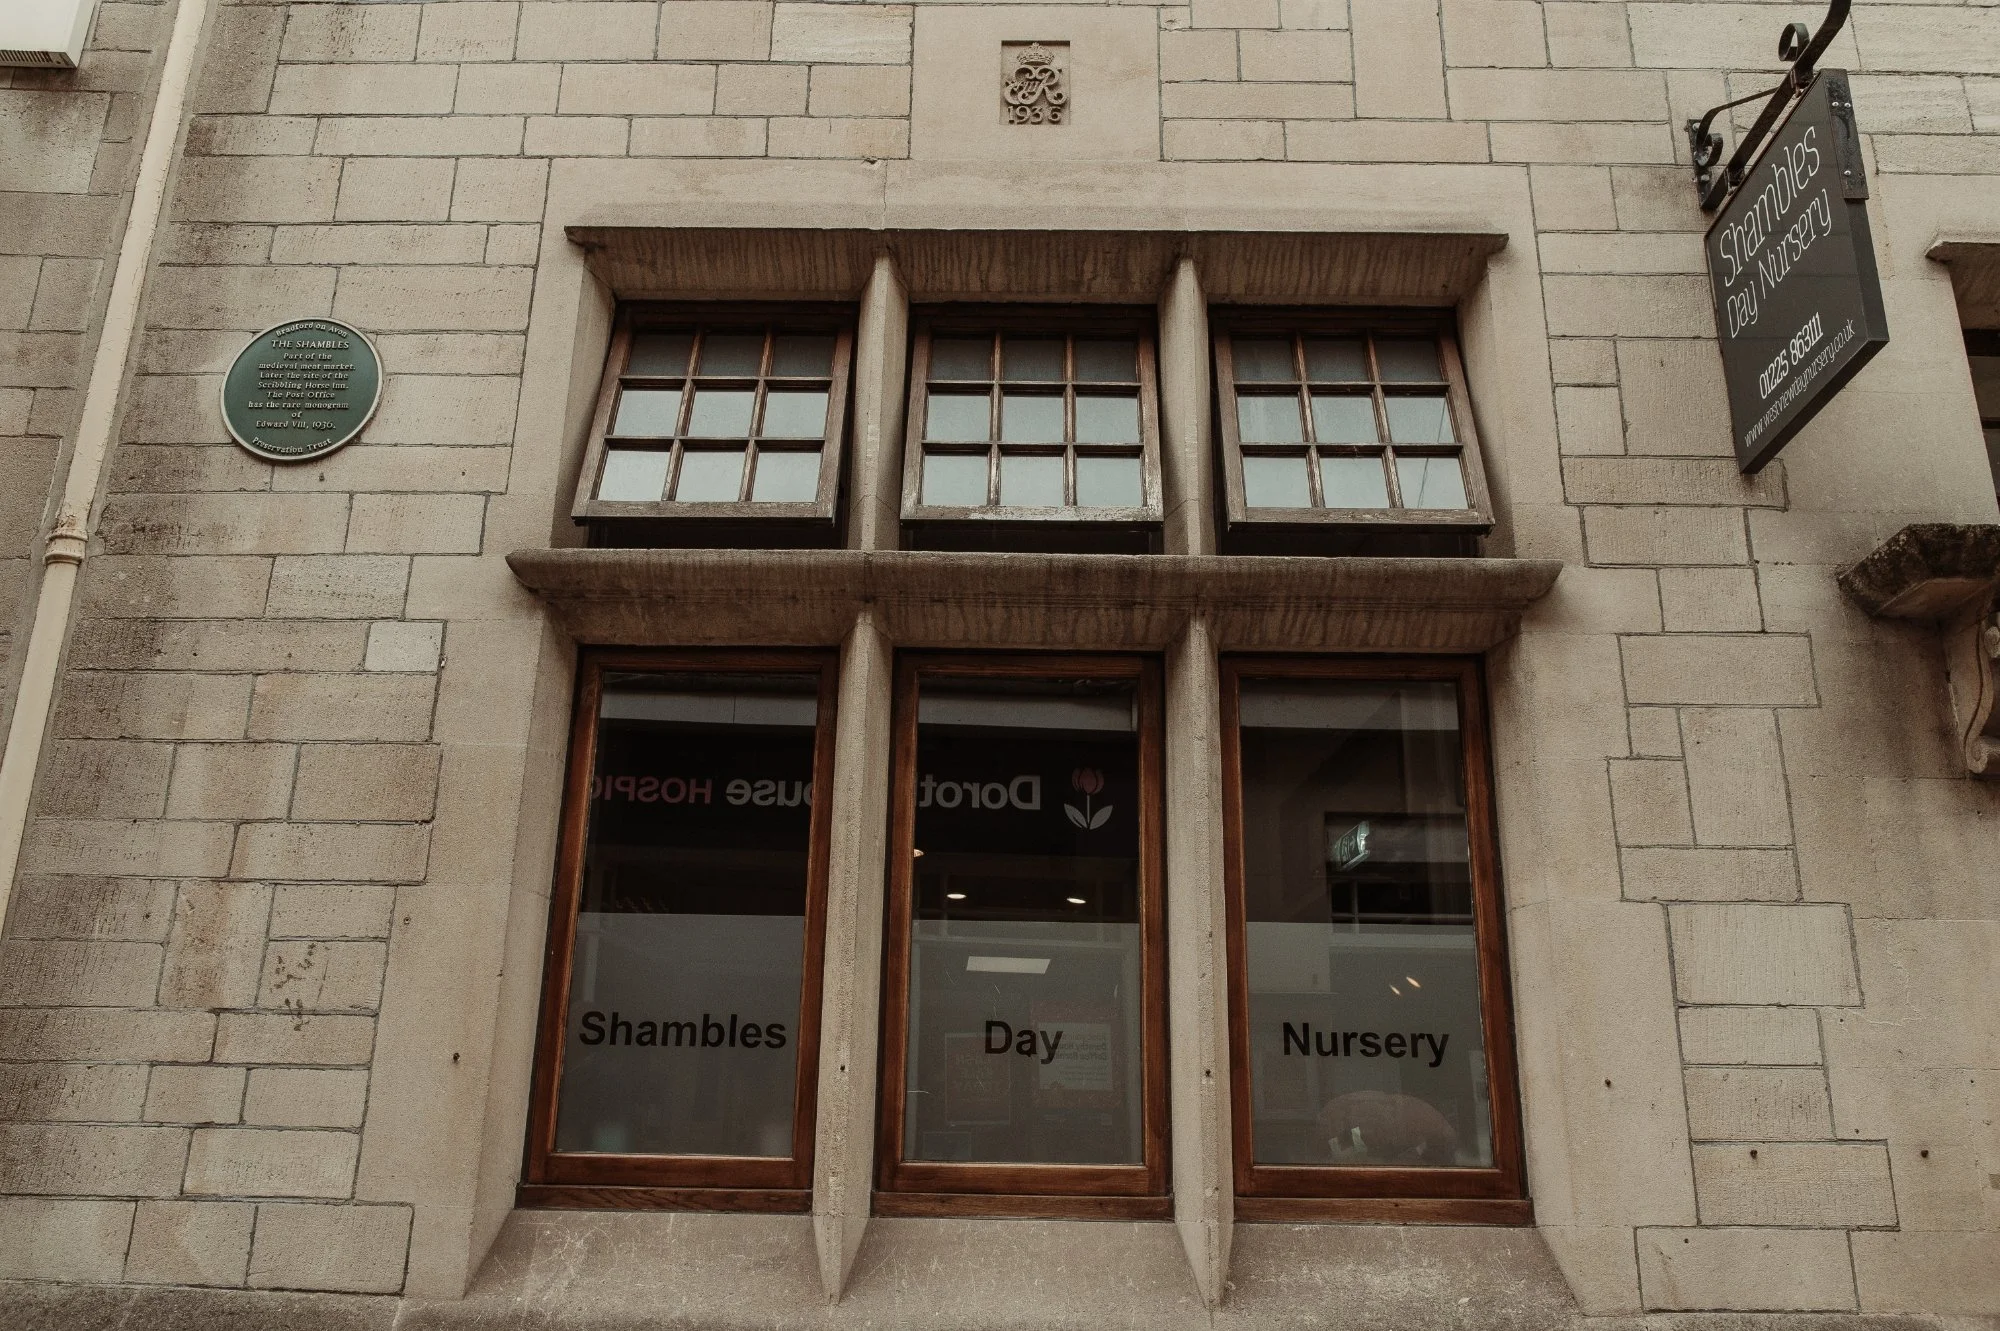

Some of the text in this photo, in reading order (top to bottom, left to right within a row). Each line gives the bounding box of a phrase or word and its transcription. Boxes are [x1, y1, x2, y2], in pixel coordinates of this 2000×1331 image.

[1007, 105, 1062, 124] 1936
[1719, 125, 1821, 288] Shambles
[1727, 188, 1832, 339] Day Nursery
[276, 322, 314, 337] Bradford
[328, 325, 348, 338] Avon
[271, 340, 350, 349] THE SHAMBLES
[283, 352, 332, 360] Part of the
[1759, 311, 1824, 400] 01225 863111
[260, 371, 349, 379] Later the site of the
[300, 362, 321, 370] meat
[323, 362, 356, 370] market.
[258, 381, 302, 390] Scribbling
[305, 381, 329, 389] Horse
[1744, 319, 1856, 448] www.westviewdaynursery.co.uk
[304, 401, 349, 409] monogram
[255, 420, 289, 428] Edward
[312, 421, 336, 430] 1936.
[252, 436, 332, 454] Preservation Trust
[579, 1011, 787, 1050] Shambles
[984, 1019, 1063, 1065] Day
[1282, 1021, 1450, 1068] Nursery
